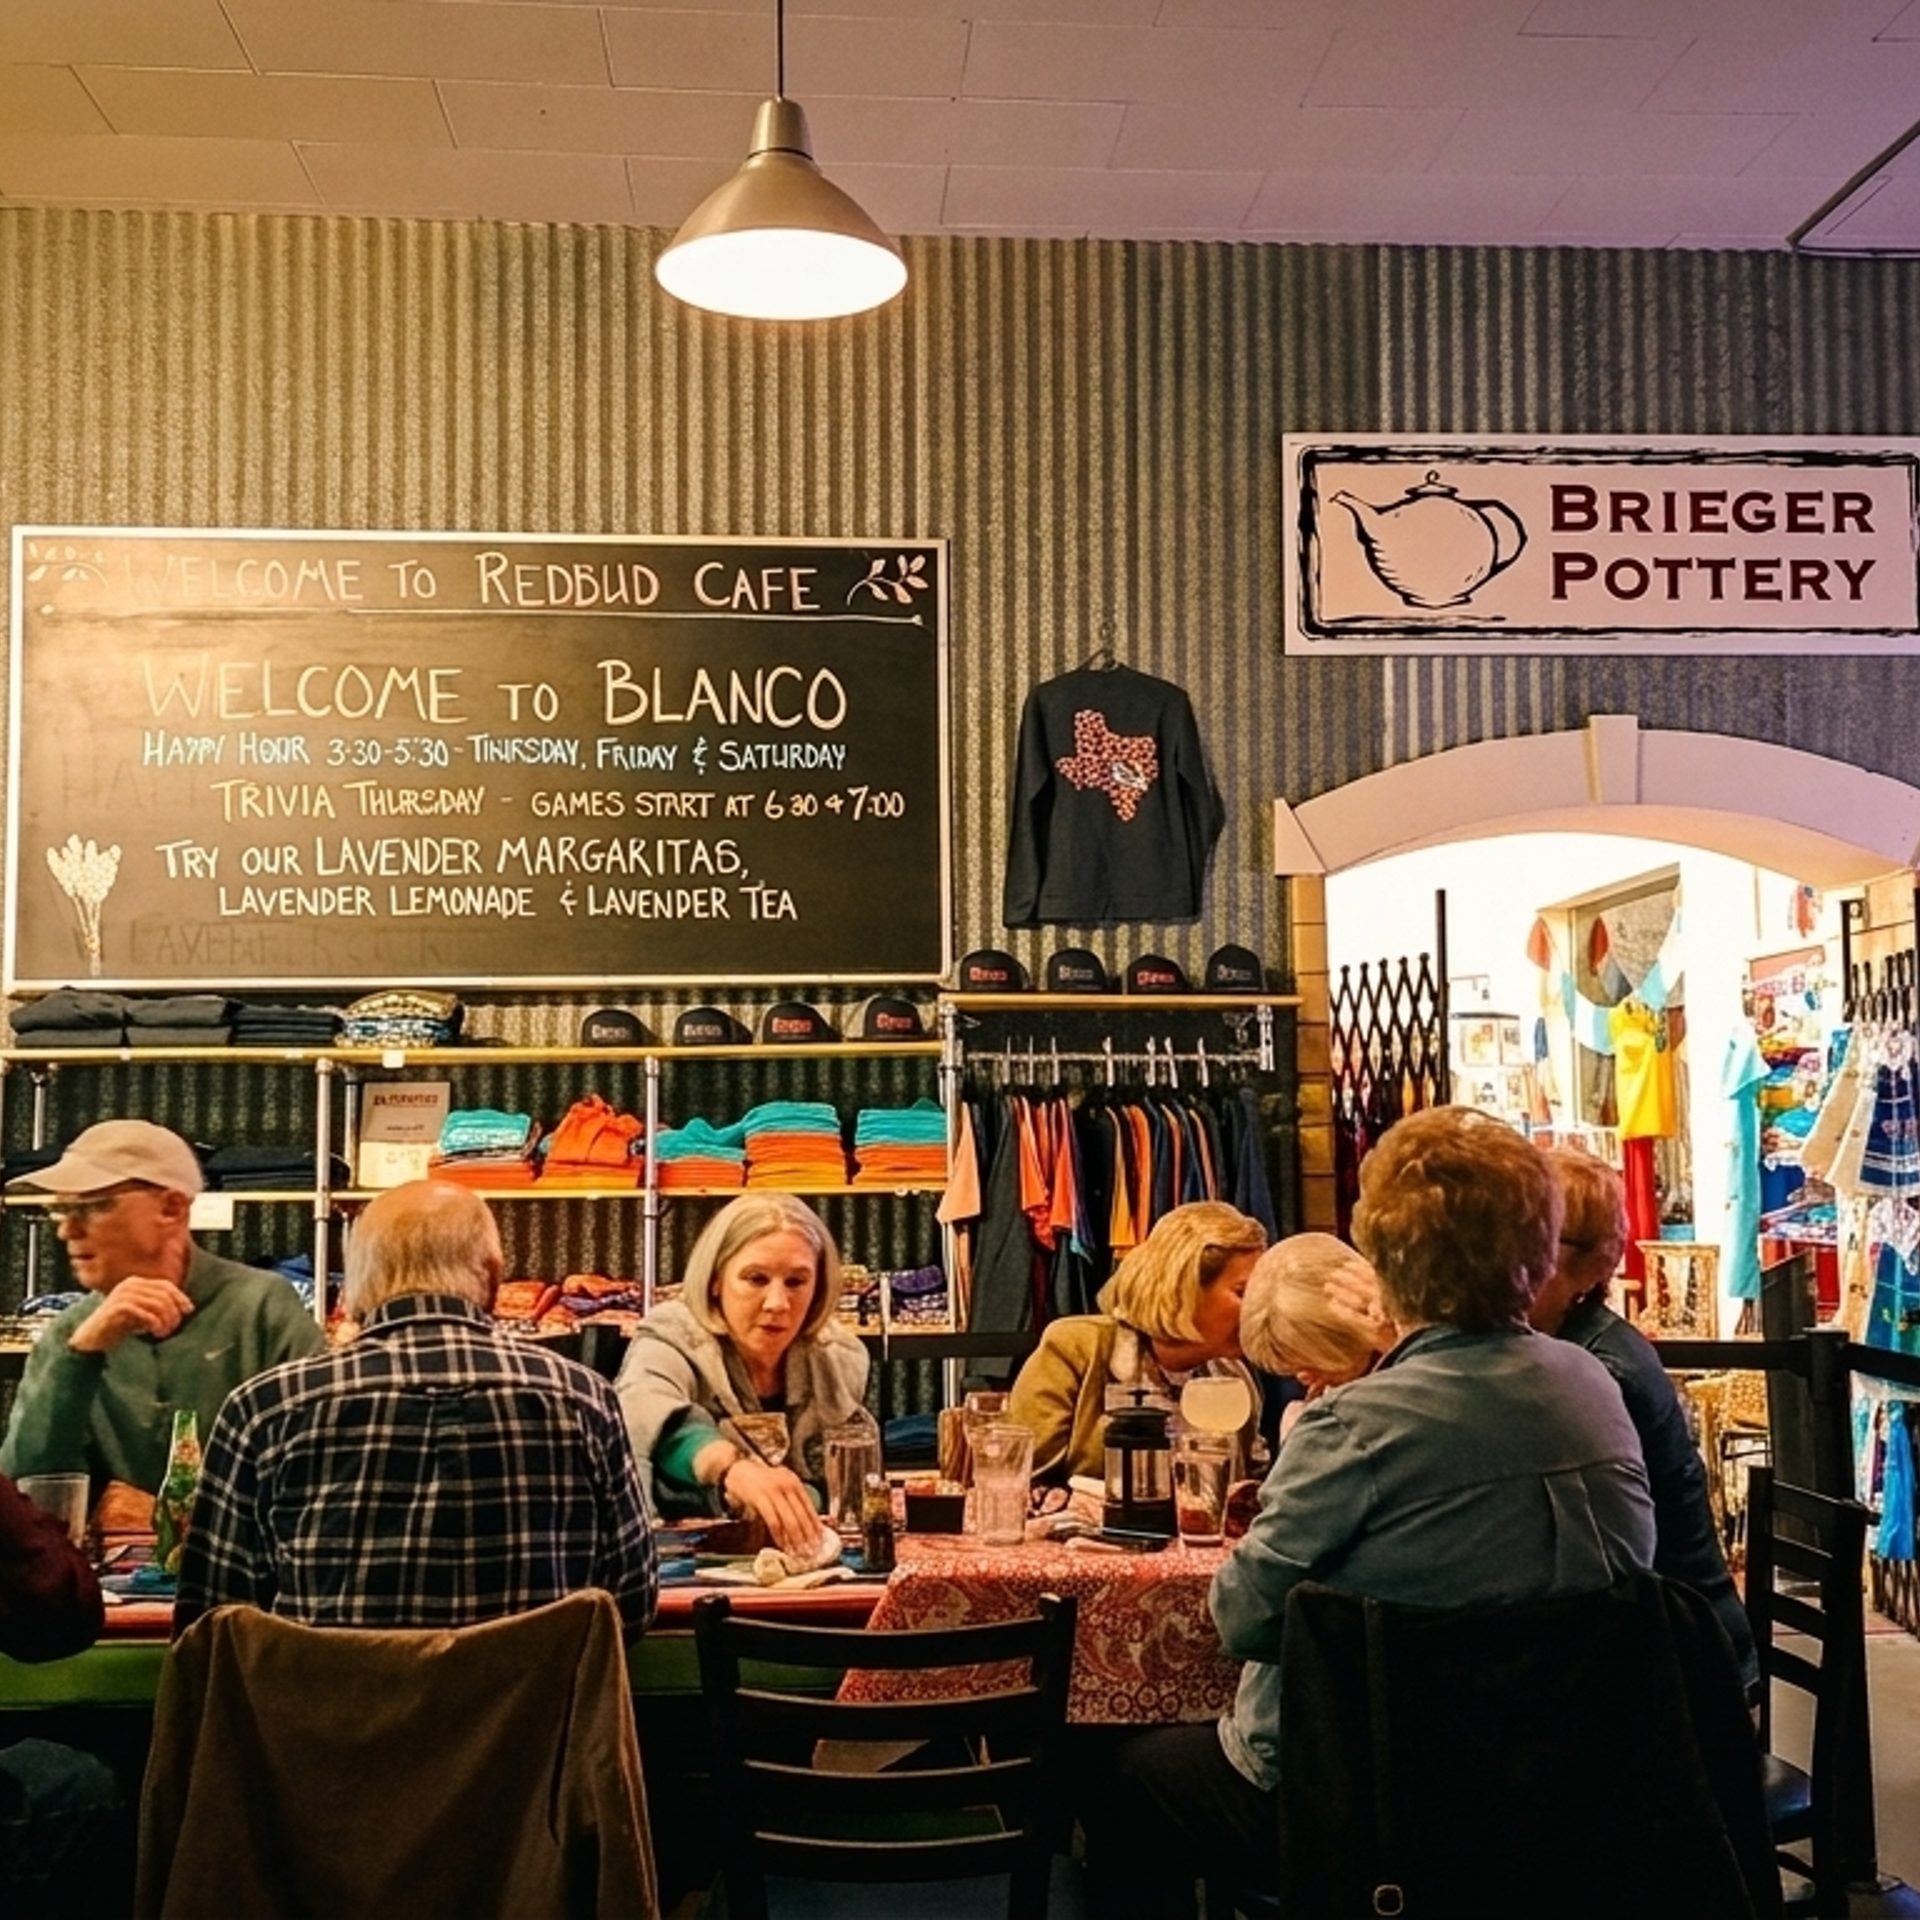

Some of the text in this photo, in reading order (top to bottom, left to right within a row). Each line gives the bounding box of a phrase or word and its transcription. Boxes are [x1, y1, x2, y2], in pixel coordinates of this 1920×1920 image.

[1549, 484, 1875, 534] BRIEGER
[124, 552, 820, 612] WELCOME TO REDBUD CAFE
[1551, 552, 1877, 601] POTTERY
[143, 653, 848, 730] WELCOME TO BLANCO
[597, 739, 677, 771] FRIDAY
[692, 737, 709, 775] &
[718, 740, 847, 772] SATURDAY
[211, 780, 337, 824] TRIVIA
[531, 791, 625, 818] GAMES
[635, 791, 715, 818] START
[725, 793, 756, 818] AT
[155, 838, 218, 879] TRY
[241, 847, 302, 876] OUR
[316, 836, 482, 877] LAVENDER
[219, 886, 376, 918] LAVENDER
[390, 886, 536, 919] LEMONADE
[587, 885, 730, 920] LAVENDER
[740, 883, 797, 920] TEA
